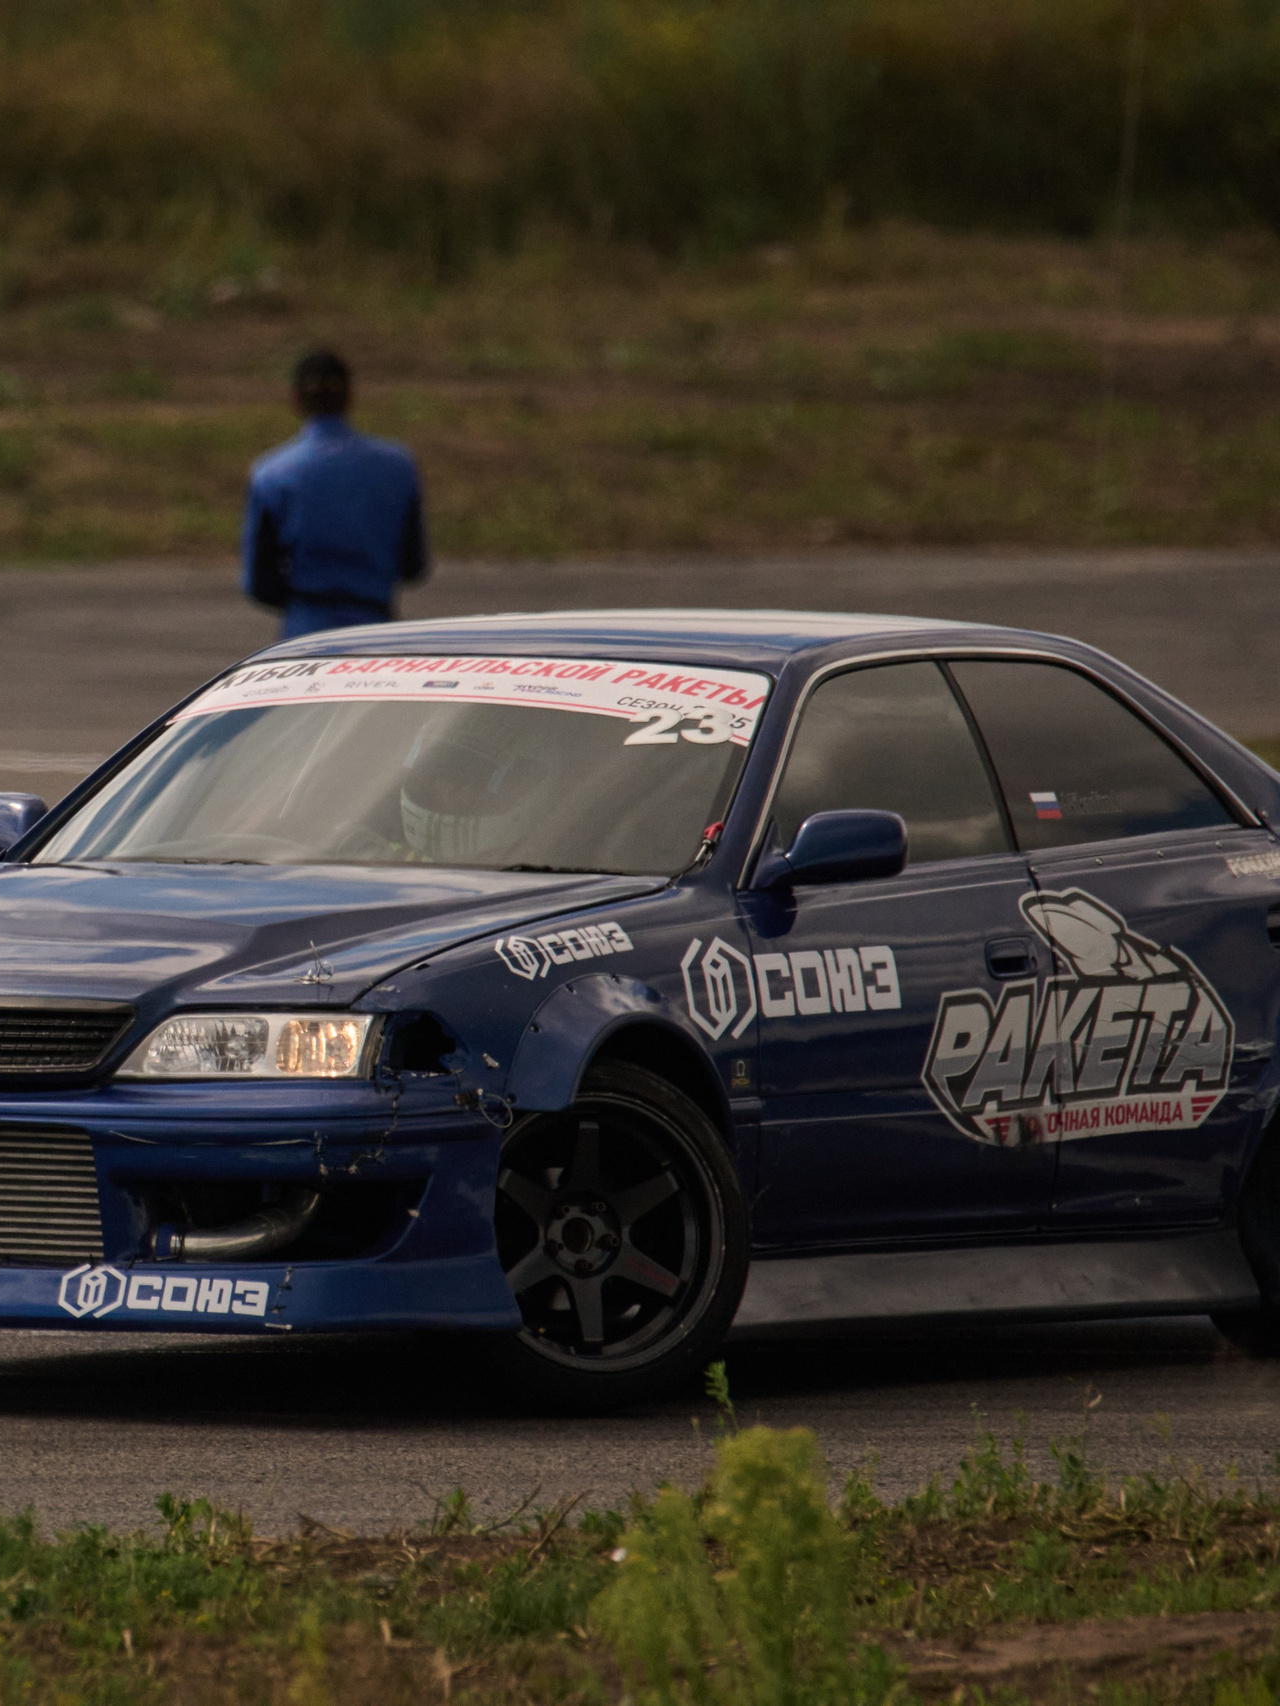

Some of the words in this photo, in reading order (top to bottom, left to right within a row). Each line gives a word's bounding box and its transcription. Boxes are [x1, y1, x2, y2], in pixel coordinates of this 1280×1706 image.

[213, 661, 332, 692] КУБОК
[325, 657, 617, 682] БАРНАУЛЬСКОЙ
[610, 669, 767, 710] РАКЕТЫ
[623, 707, 734, 746] 23
[537, 921, 635, 965] СОЮЗ
[753, 945, 902, 1018] СОЮЗ
[928, 981, 1228, 1109] РАКЕТА
[1103, 1100, 1184, 1128] КОМАНДА
[126, 1274, 270, 1317] СОЮЗ
